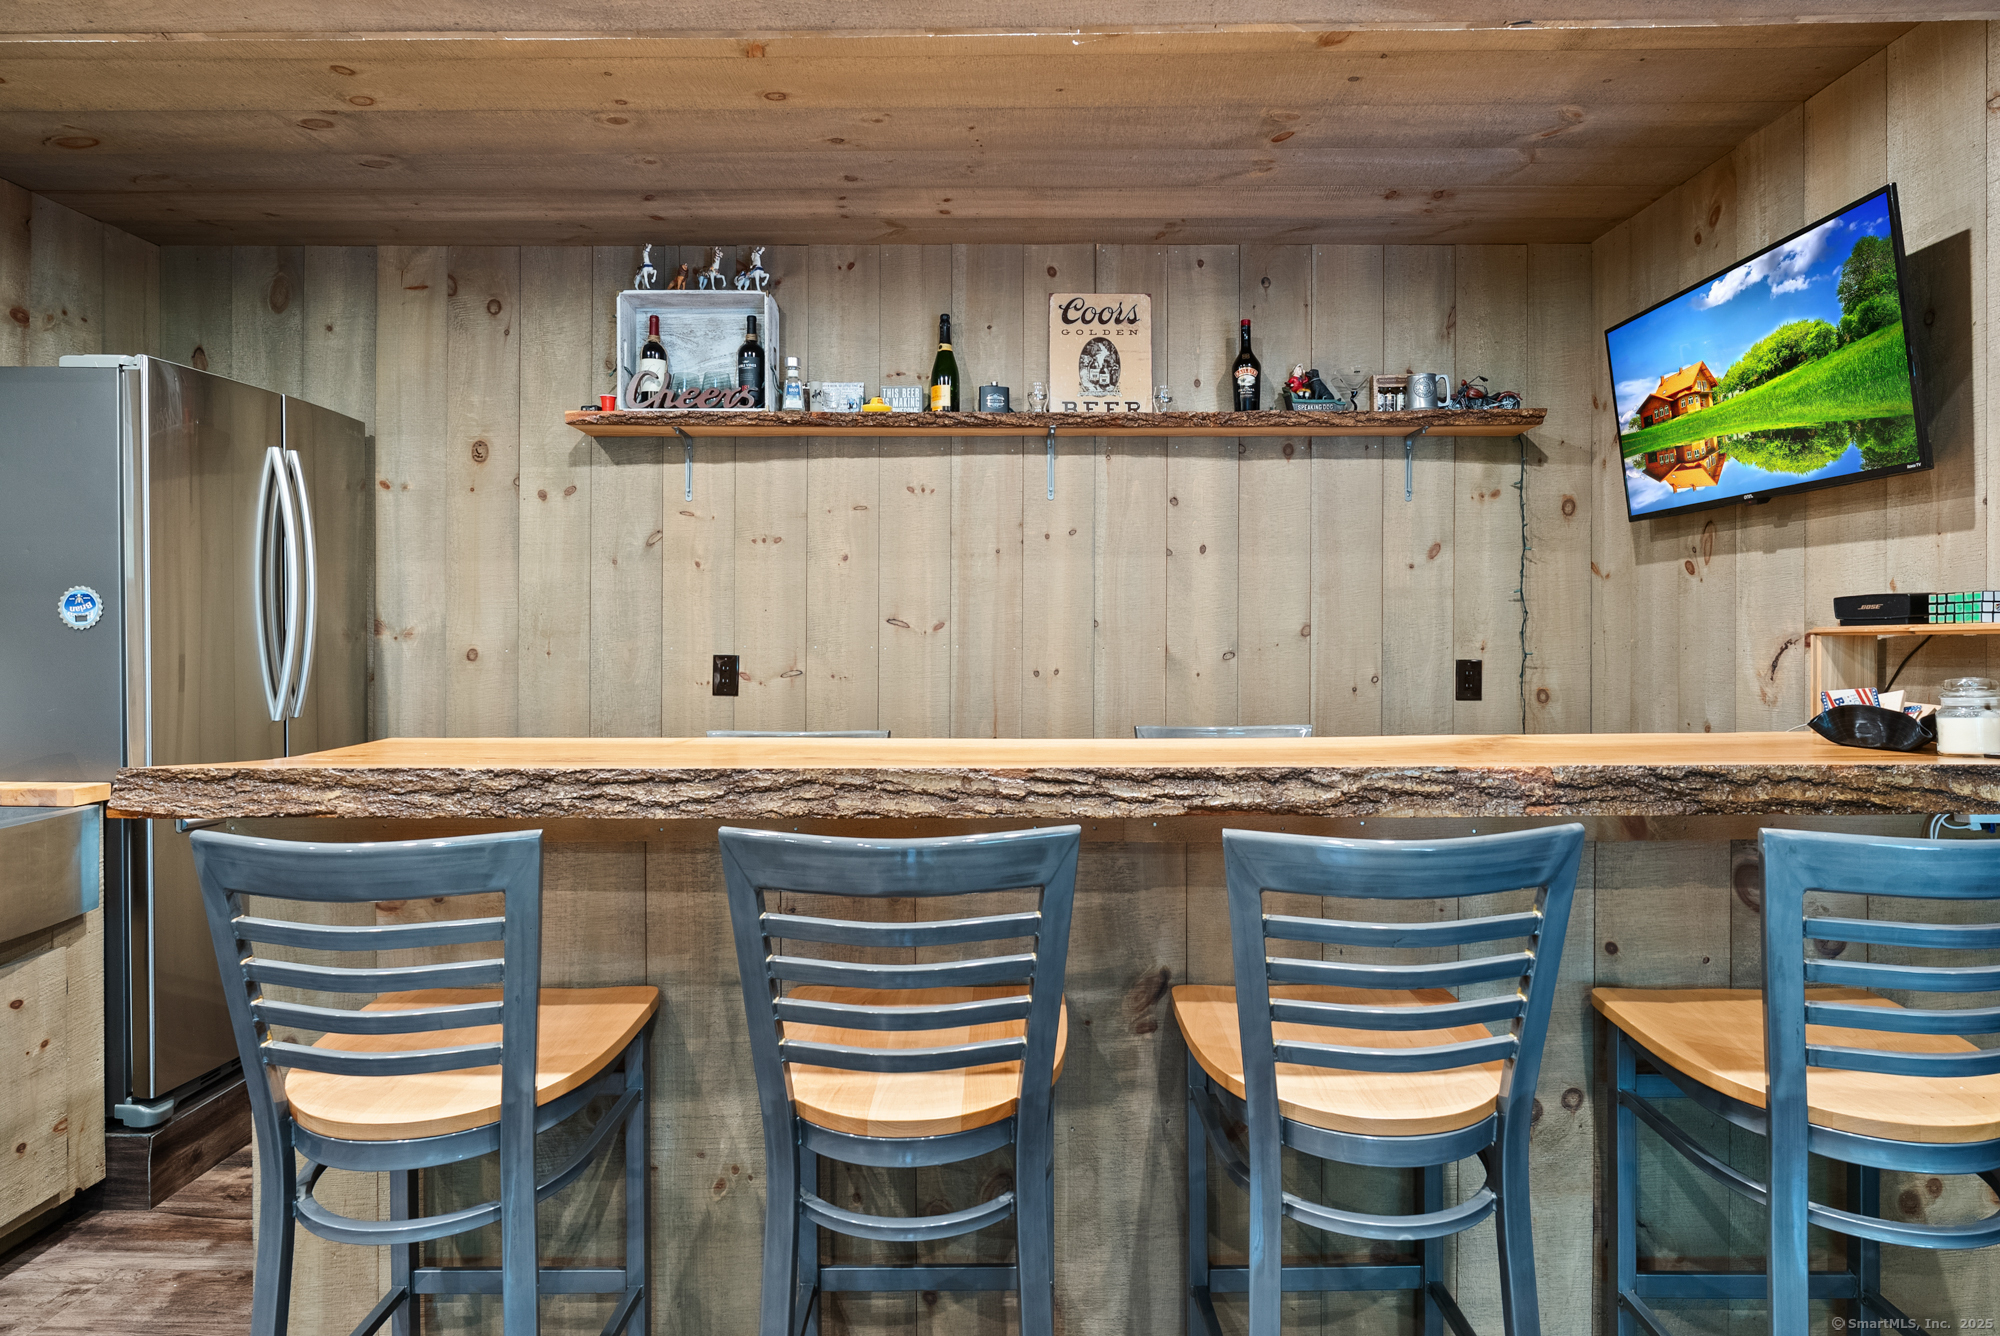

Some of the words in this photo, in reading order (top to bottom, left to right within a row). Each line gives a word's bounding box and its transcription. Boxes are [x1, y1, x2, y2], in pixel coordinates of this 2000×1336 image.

[1059, 297, 1140, 325] Coors
[625, 370, 759, 408] Cheers
[882, 388, 899, 398] THIS
[902, 387, 920, 398] BEER
[892, 397, 920, 408] MAKING
[1061, 401, 1141, 413] BEER
